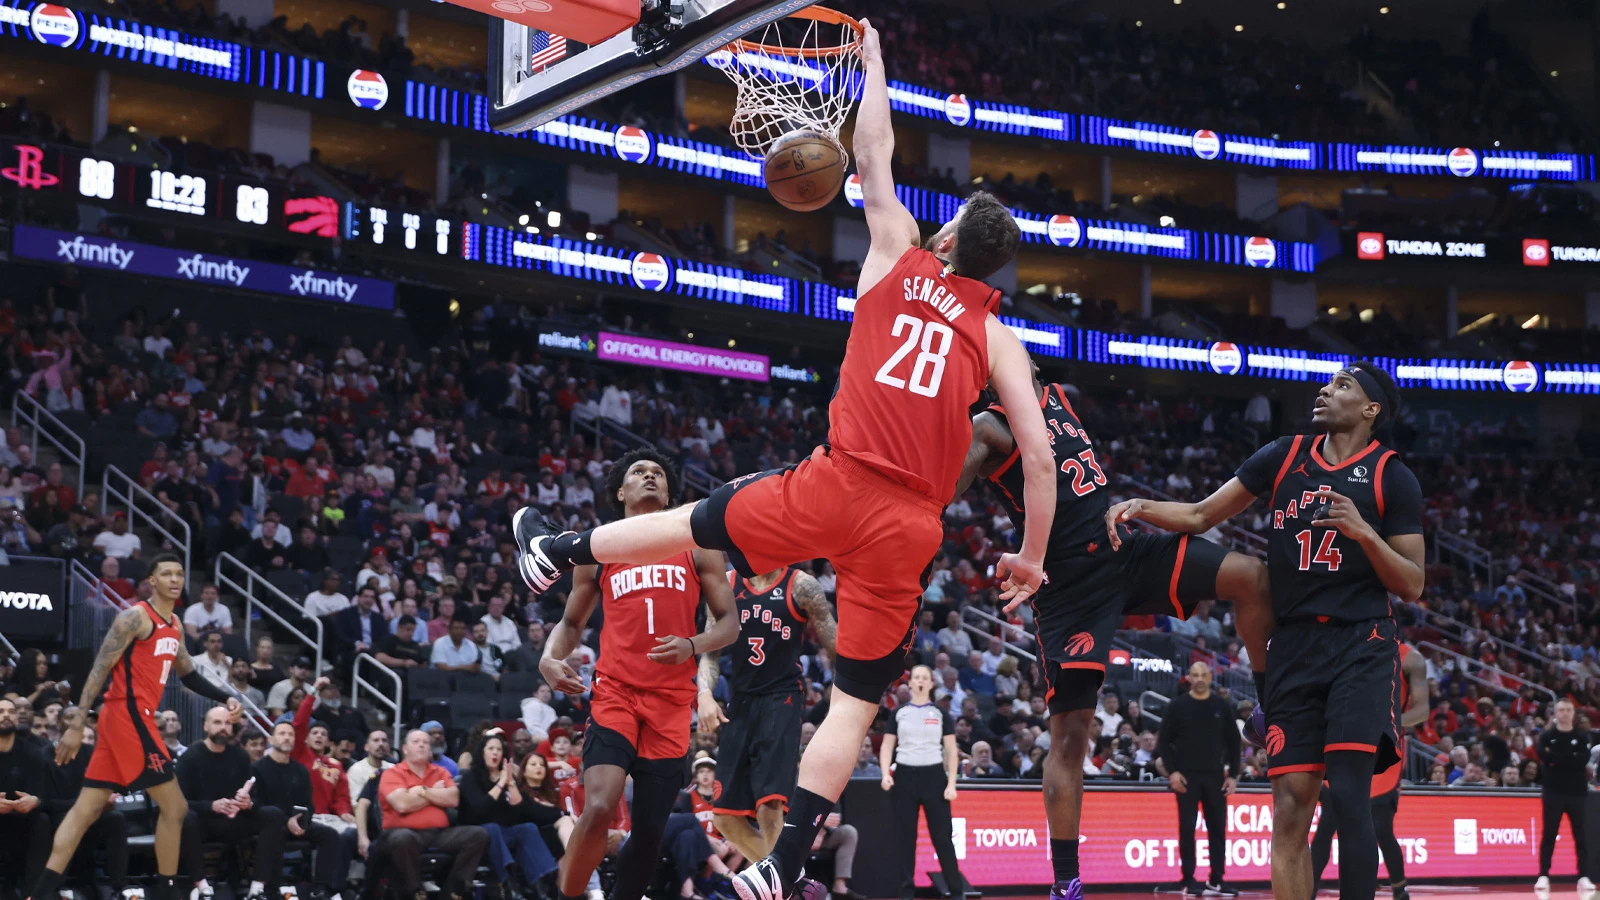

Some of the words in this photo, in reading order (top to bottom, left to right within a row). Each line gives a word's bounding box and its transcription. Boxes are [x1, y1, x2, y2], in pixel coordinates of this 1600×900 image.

[690, 36, 729, 55] Turkey
[57, 236, 134, 270] xfinity
[1386, 240, 1442, 256] TUNDRA
[1446, 242, 1486, 258] ZONE
[177, 254, 250, 286] xfinity
[290, 270, 358, 302] xfinity
[903, 276, 966, 322] SENGUN
[539, 331, 581, 350] reliant
[874, 313, 954, 398] 28
[602, 340, 659, 360] OFFICIAL
[660, 347, 706, 367] ENERGY
[708, 357, 765, 375] PROVIDER
[771, 364, 808, 382] reliant
[1061, 448, 1107, 497] 23
[1274, 485, 1332, 530] RAPT
[1295, 529, 1343, 571] 14
[609, 564, 687, 601] ROCKETS
[0, 591, 54, 612] YOTA
[644, 597, 655, 635] 1
[740, 604, 791, 640] PTORS
[747, 637, 766, 666] 3
[973, 828, 1037, 847] TOYOTA
[1481, 828, 1526, 844] TOYOTA
[1124, 838, 1160, 868] OF
[1162, 839, 1211, 867] TE
